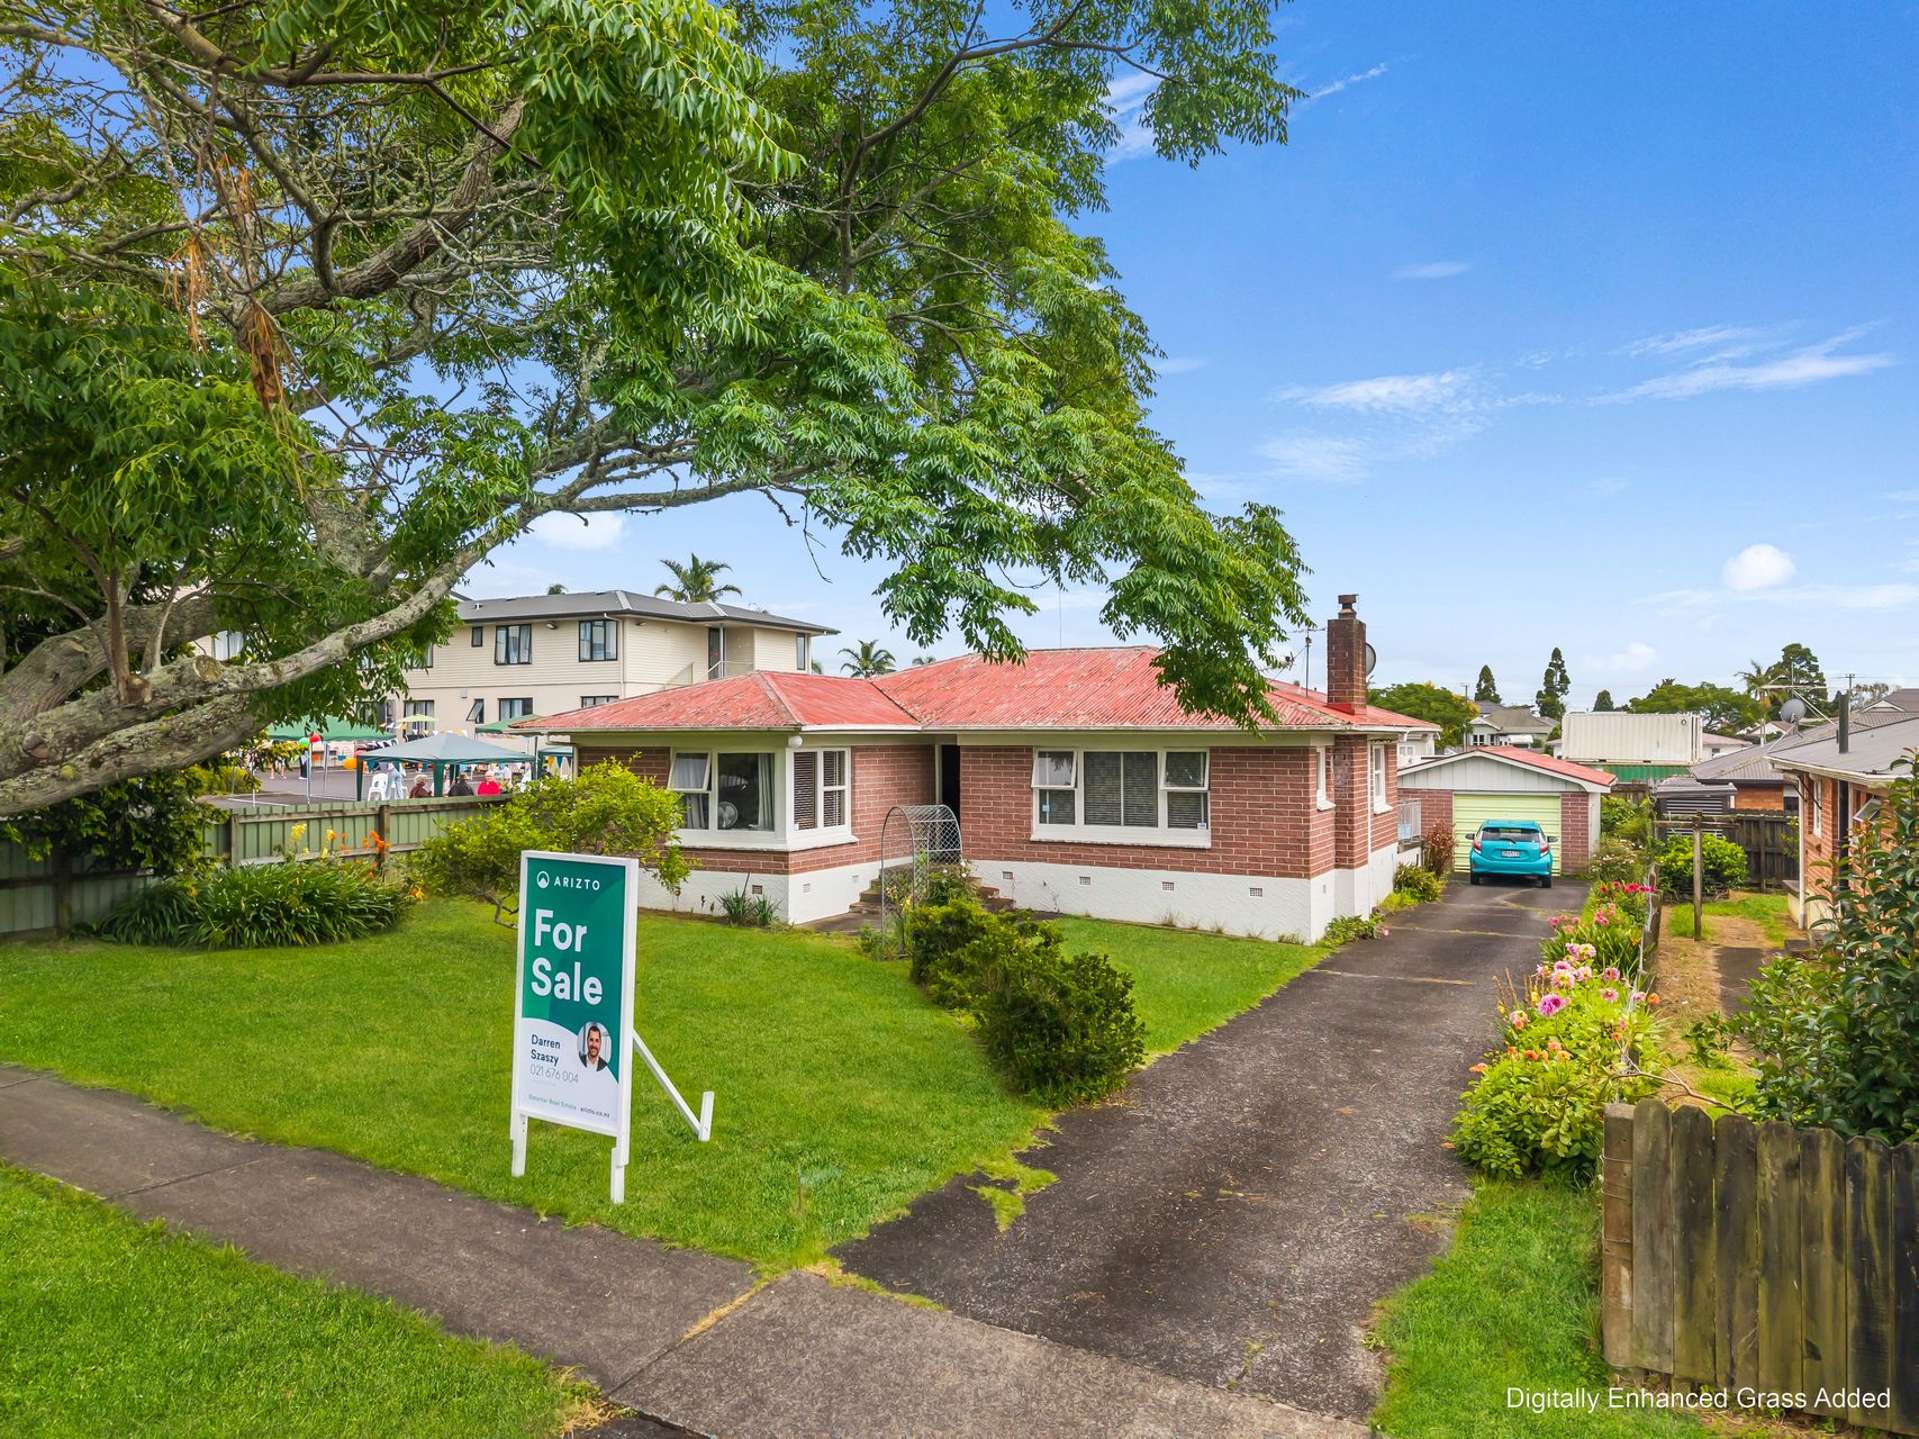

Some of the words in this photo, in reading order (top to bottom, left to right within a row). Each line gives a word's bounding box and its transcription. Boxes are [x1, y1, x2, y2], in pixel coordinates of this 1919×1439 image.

[553, 875, 600, 891] ARIZTO
[534, 908, 588, 952] For
[531, 957, 603, 1006] Sale
[531, 1034, 561, 1049] Darren
[530, 1049, 560, 1067] Szaszy
[530, 1064, 544, 1077] 021
